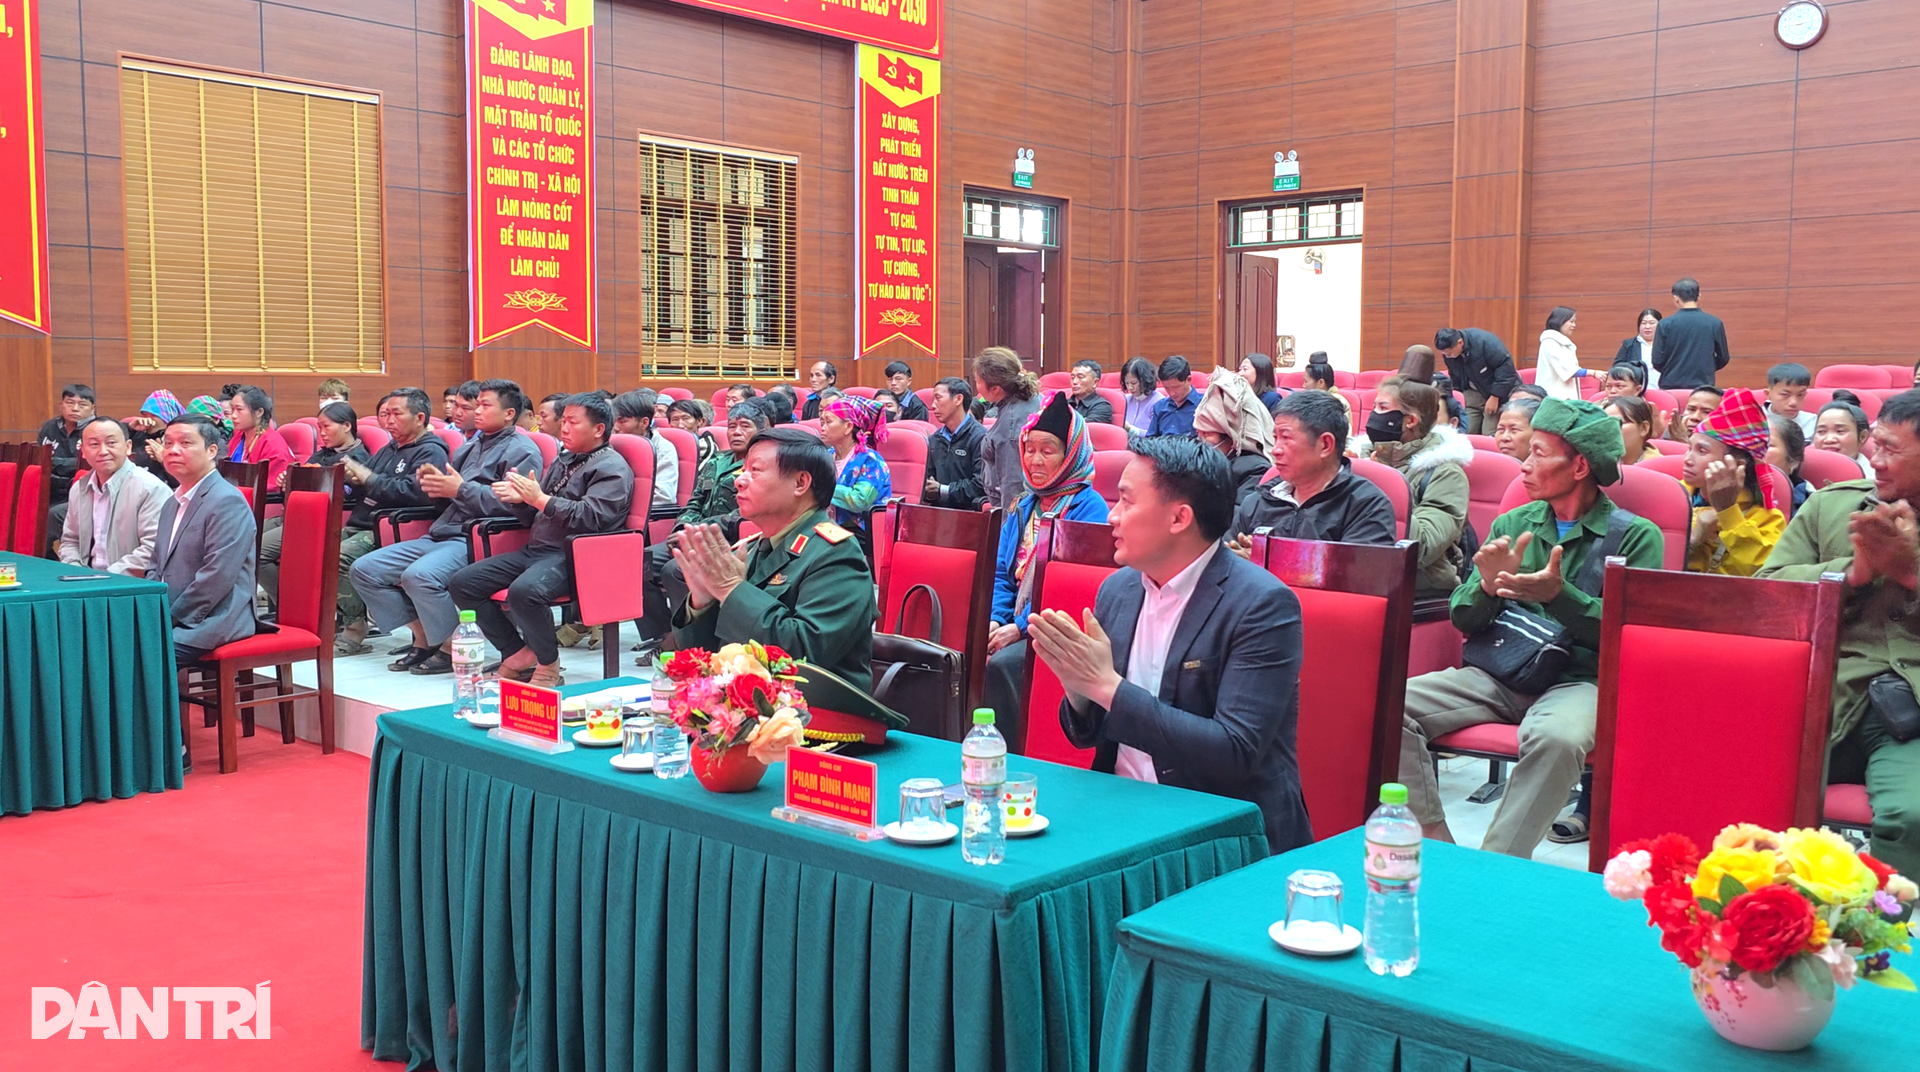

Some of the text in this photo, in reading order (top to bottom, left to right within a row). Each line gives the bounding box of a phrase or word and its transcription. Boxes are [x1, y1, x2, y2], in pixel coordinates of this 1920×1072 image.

[490, 42, 575, 80] ĐẢNG LÃNH ĐẠO,
[482, 74, 583, 111] NHÀ NƯỚC QUẢN LÝ,
[484, 104, 582, 138] MẶT TRẬN TỔ QUỐC
[882, 111, 920, 136] XÂY DỰNG,
[492, 134, 575, 165] VÀ CÁC TỔ CHỨC
[880, 136, 922, 158] PHÁT TRIỂN
[486, 164, 520, 188] CHÍNH
[521, 170, 538, 194] TRỊ
[547, 171, 562, 192] XÃ
[563, 173, 581, 198] HỘI
[872, 157, 929, 183] ĐẤT NƯỚC TRÊN
[496, 194, 573, 222] LÀM NÒNG CỐT
[882, 186, 899, 204] TINH
[900, 210, 918, 231] CHỦ,
[500, 221, 570, 251] ĐỂ NHÂN DÂN
[875, 234, 928, 257] TỰ TIN, TỰ LỰC,
[510, 255, 560, 279] LÀM CHỦ!
[882, 258, 920, 279] TỰ CƯỜNG,
[868, 282, 879, 301] TỰ
[879, 281, 894, 300] HÀO
[895, 282, 911, 300] DÂN
[553, 476, 568, 492] LOVE
[505, 694, 557, 721] LƯU TRỌNG LƯ
[792, 769, 871, 804] PHẠM ĐÌNH MẠNH
